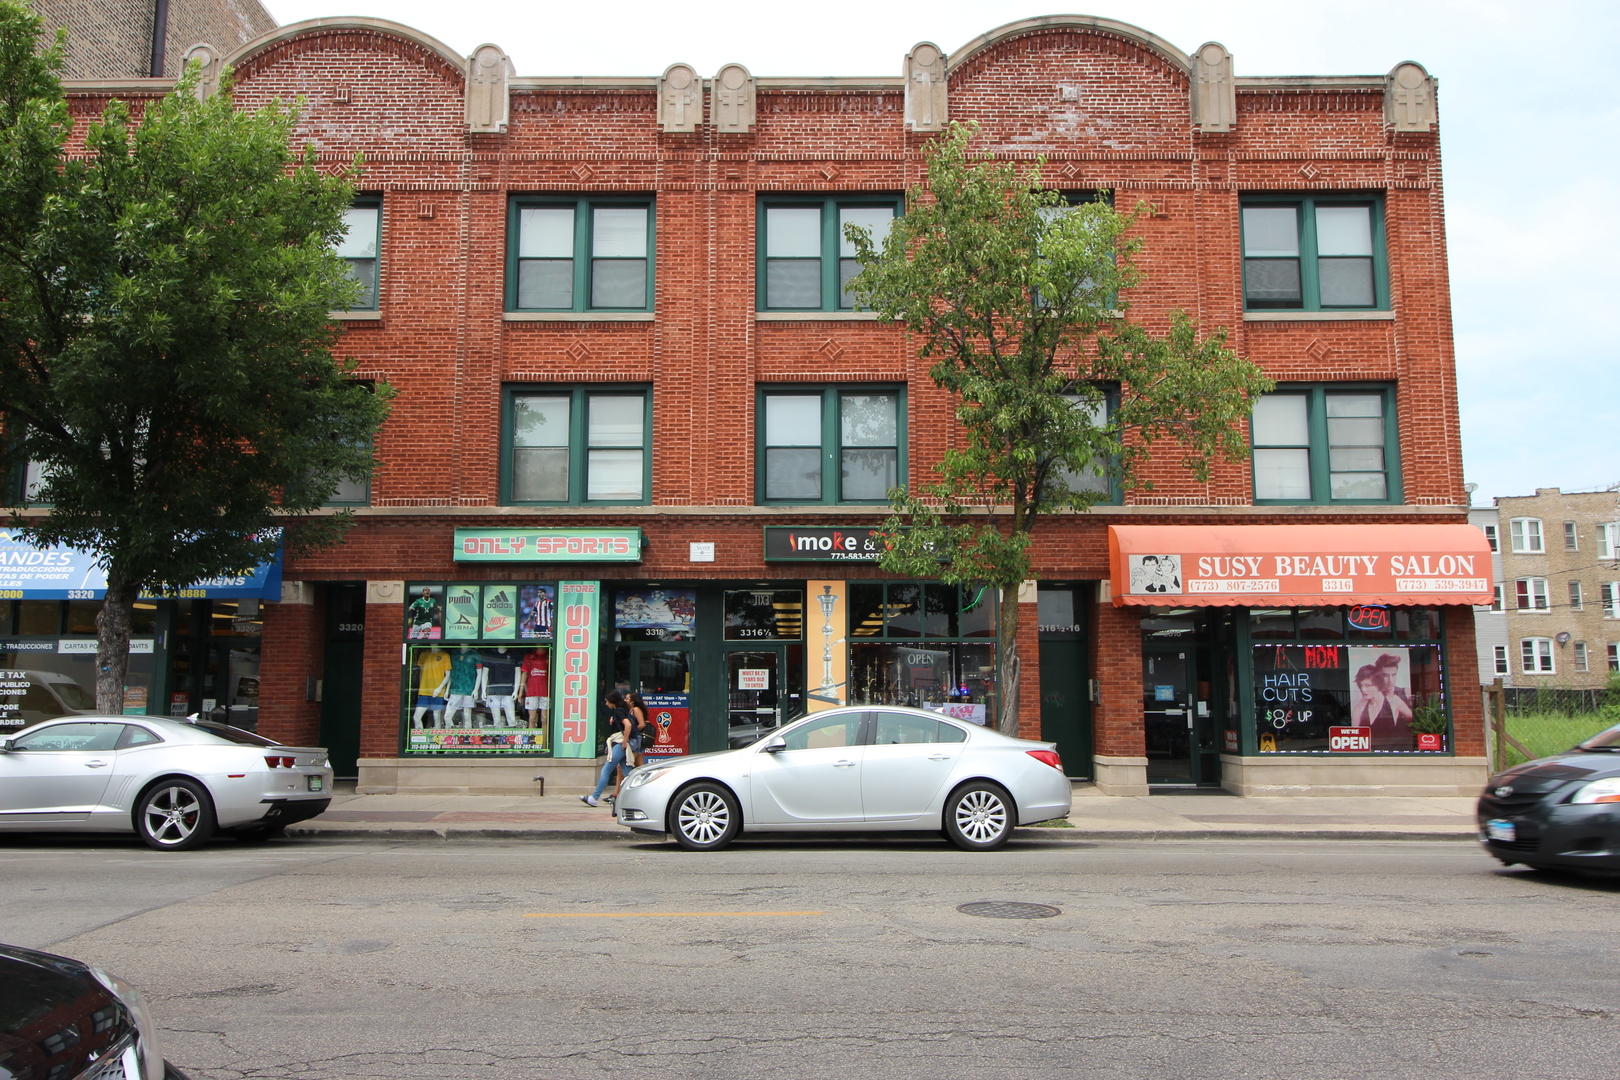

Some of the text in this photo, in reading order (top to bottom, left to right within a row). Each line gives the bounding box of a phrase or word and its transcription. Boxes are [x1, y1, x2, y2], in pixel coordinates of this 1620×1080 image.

[463, 537, 629, 554] ONLY SPORTS
[863, 539, 876, 550] &
[1198, 555, 1475, 577] SUSY BEAUTY SALON
[562, 585, 596, 593] STORE
[1190, 580, 1278, 591] (773) 807-2576
[1324, 580, 1351, 590] 3316
[1398, 579, 1485, 590] (773) 539-3947
[67, 590, 95, 599] 3320
[449, 596, 472, 604] PUMA
[490, 616, 508, 626] NIKE
[1350, 605, 1389, 627] OPEN
[339, 623, 364, 631] 3320
[907, 653, 934, 665] OPEN
[1304, 646, 1339, 669] MON
[7, 671, 26, 679] TAX
[562, 604, 591, 744] SOCCER
[1264, 673, 1310, 687] HAIR
[174, 694, 187, 702] COPY
[1262, 687, 1312, 702] CUTS
[172, 704, 186, 712] PRINT
[1297, 710, 1313, 722] UP
[1331, 736, 1369, 750] OPEN
